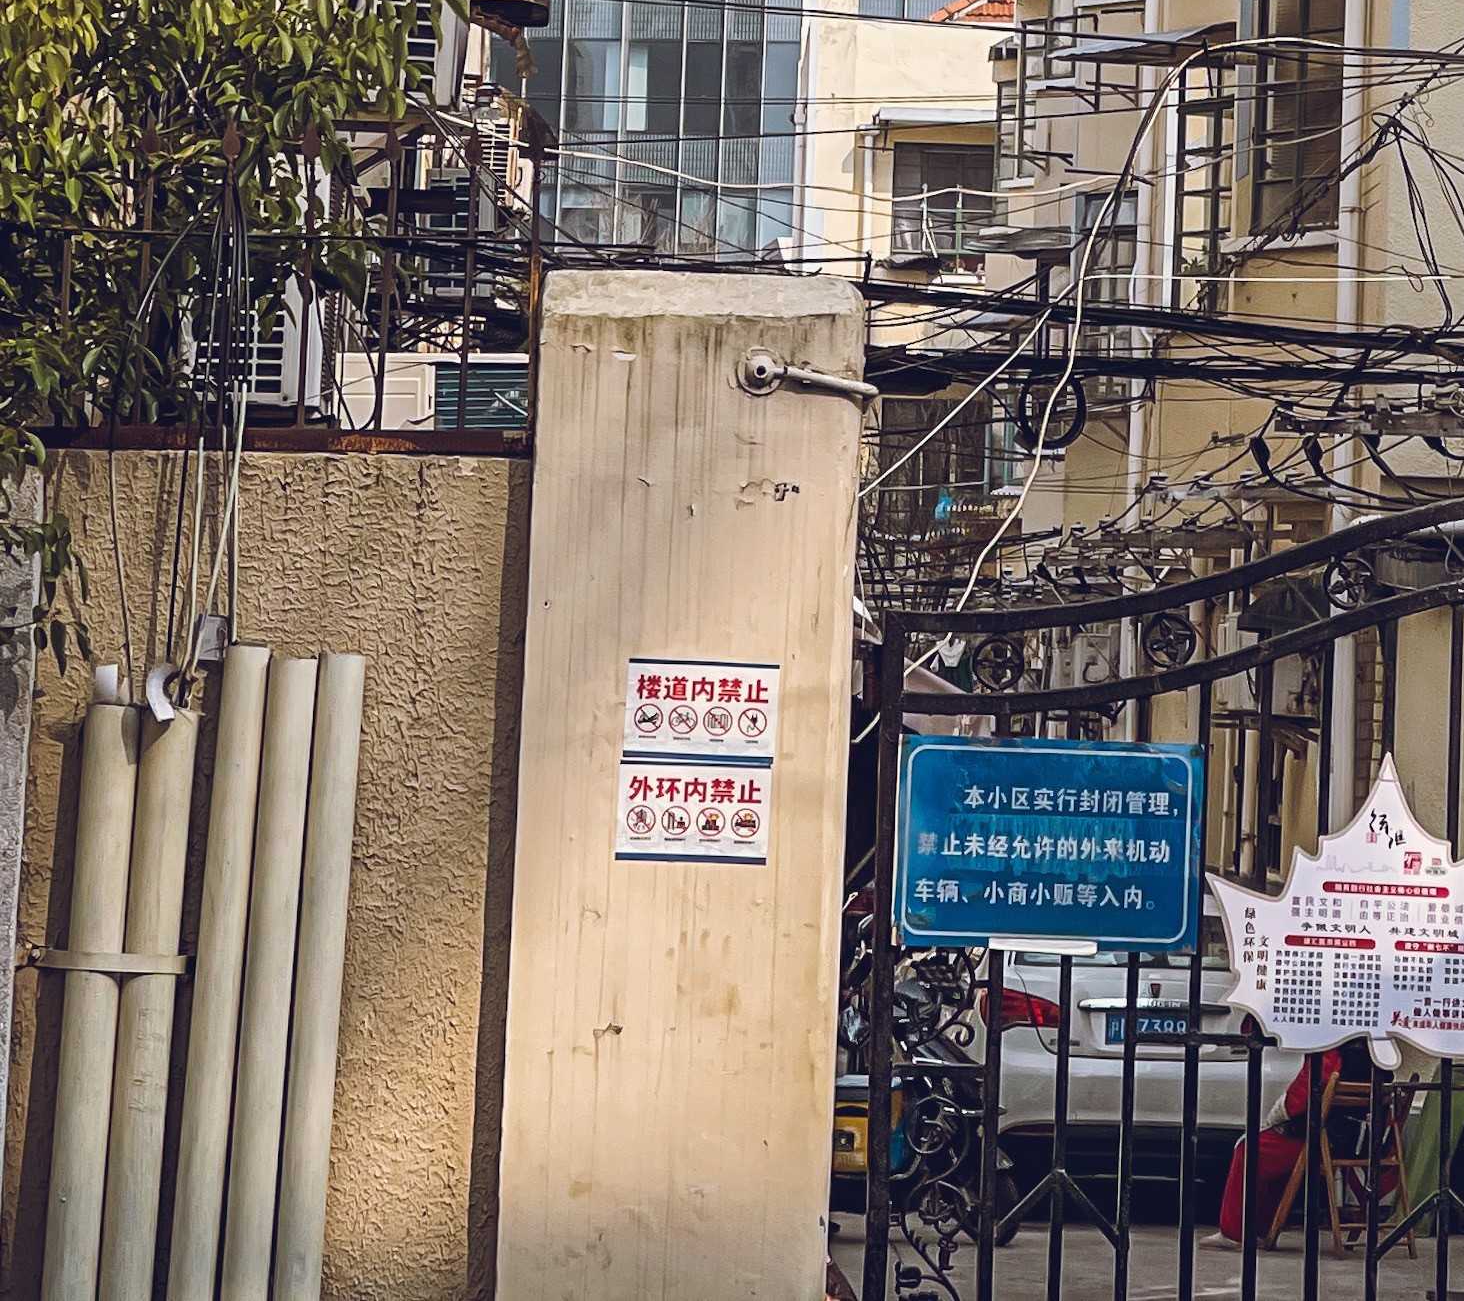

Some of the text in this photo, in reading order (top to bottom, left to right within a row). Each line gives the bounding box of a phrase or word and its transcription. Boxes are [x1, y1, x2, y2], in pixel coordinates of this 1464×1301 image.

[636, 673, 770, 704] 楼道内禁止
[627, 775, 763, 805] 外环内禁止
[1243, 907, 1256, 963] 绿色环保
